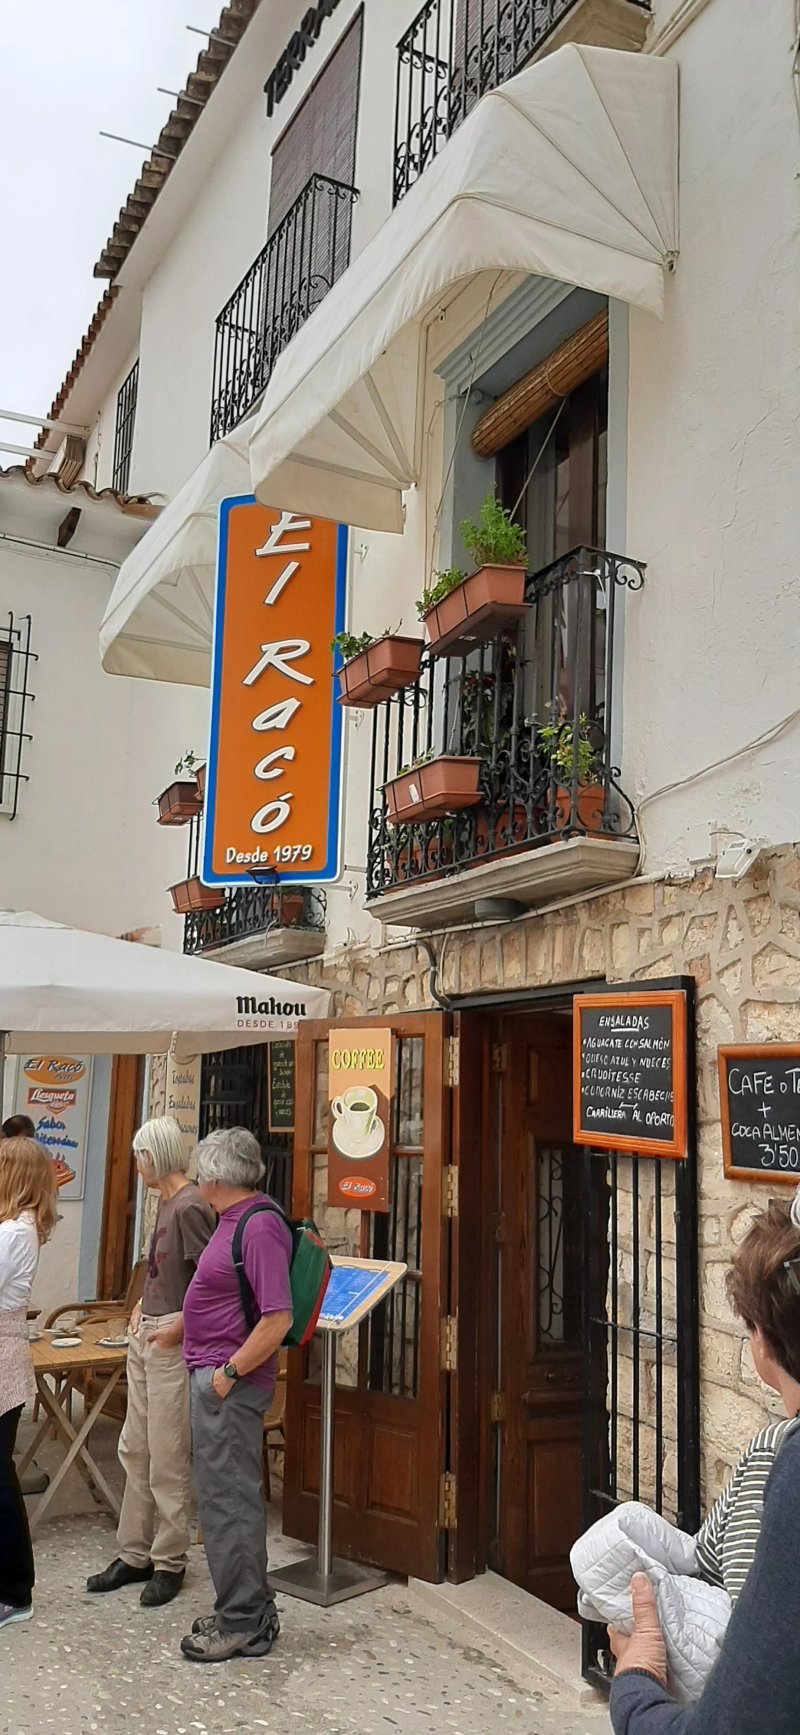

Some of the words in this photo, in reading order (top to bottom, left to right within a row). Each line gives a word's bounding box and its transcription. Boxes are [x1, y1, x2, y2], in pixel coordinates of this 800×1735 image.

[255, 510, 312, 607] El
[242, 639, 315, 835] Racó
[225, 846, 268, 863] Desde
[273, 844, 313, 863] 1979
[236, 996, 307, 1016] Mahou
[237, 1019, 274, 1028] DESDE
[280, 1020, 299, 1029] 189
[598, 1014, 650, 1030] ENSALADAS
[586, 1036, 622, 1049] AGUACATE
[24, 1058, 45, 1072] El
[332, 1048, 385, 1070] COFFEE
[610, 1055, 629, 1067] AZUL
[728, 1067, 775, 1095] CAFE
[632, 1109, 643, 1122] AL
[645, 1110, 675, 1128] OPORTO
[731, 1122, 760, 1140] COCA
[758, 1142, 799, 1168] 3'50
